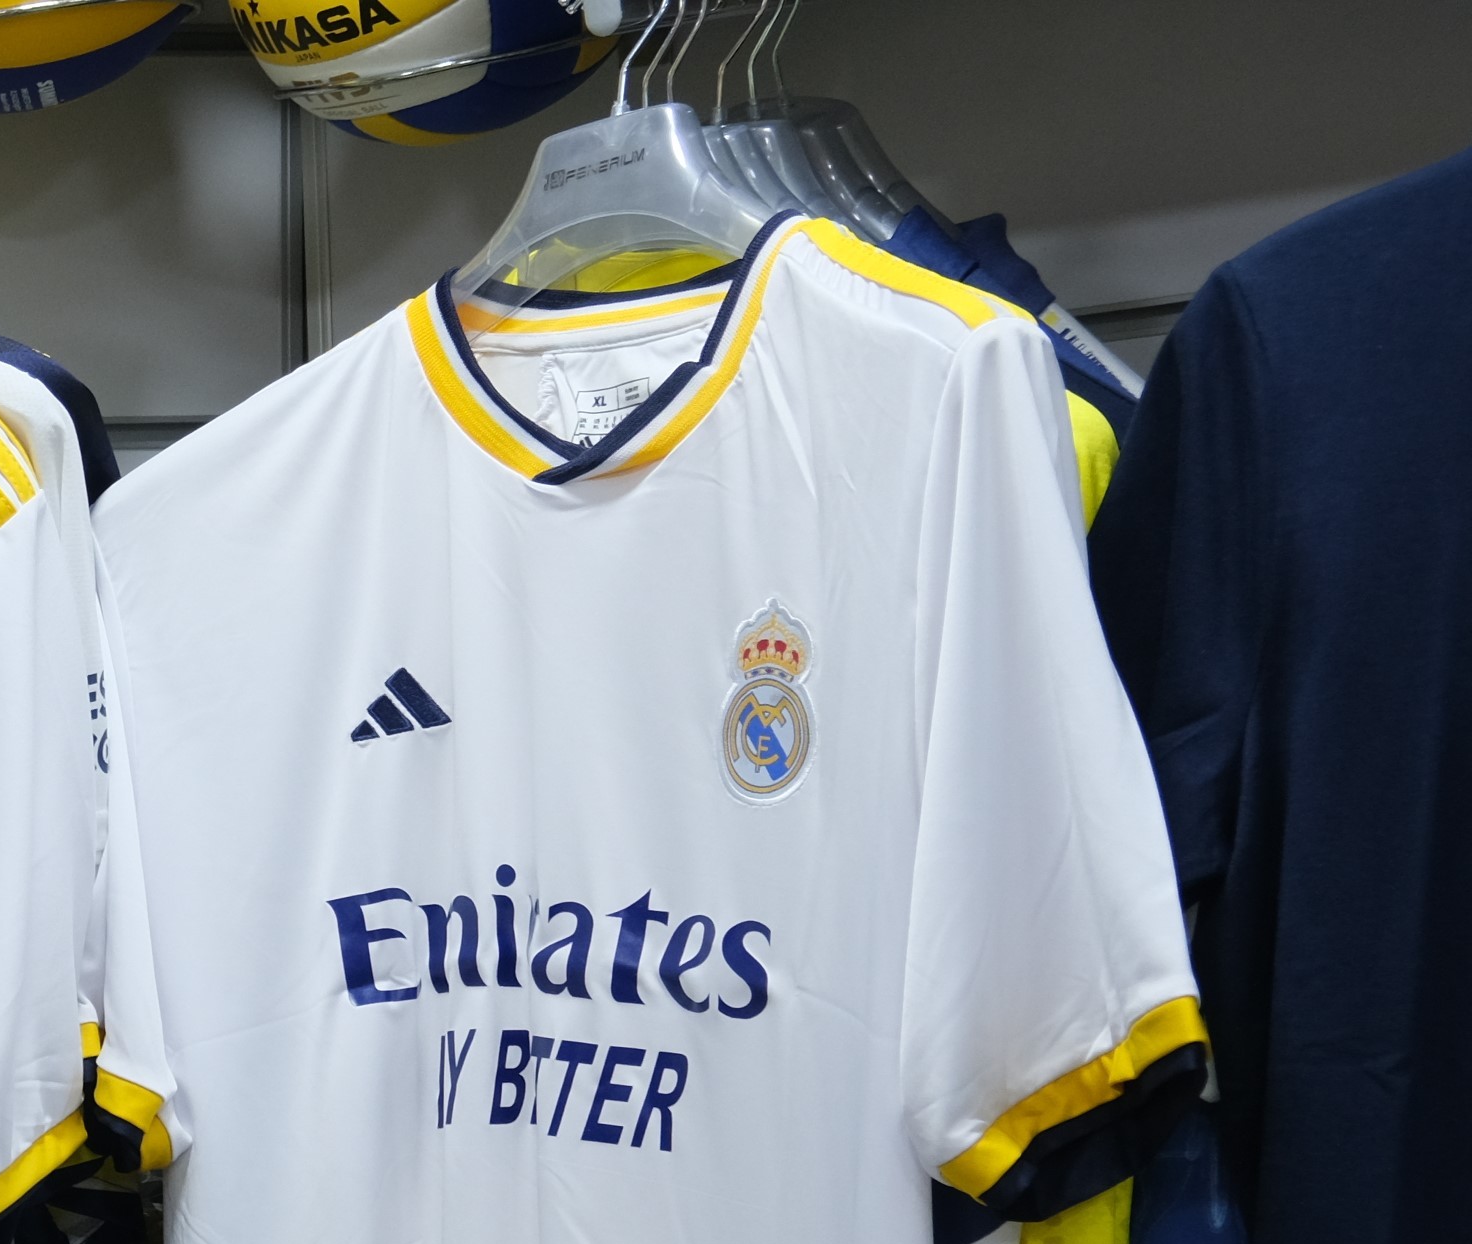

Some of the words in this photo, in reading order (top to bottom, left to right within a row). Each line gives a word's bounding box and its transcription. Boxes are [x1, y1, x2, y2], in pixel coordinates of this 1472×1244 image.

[233, 0, 401, 54] MIKASA
[296, 53, 321, 62] JAPAN
[592, 396, 607, 407] XL
[489, 1029, 688, 1152] BTTER
